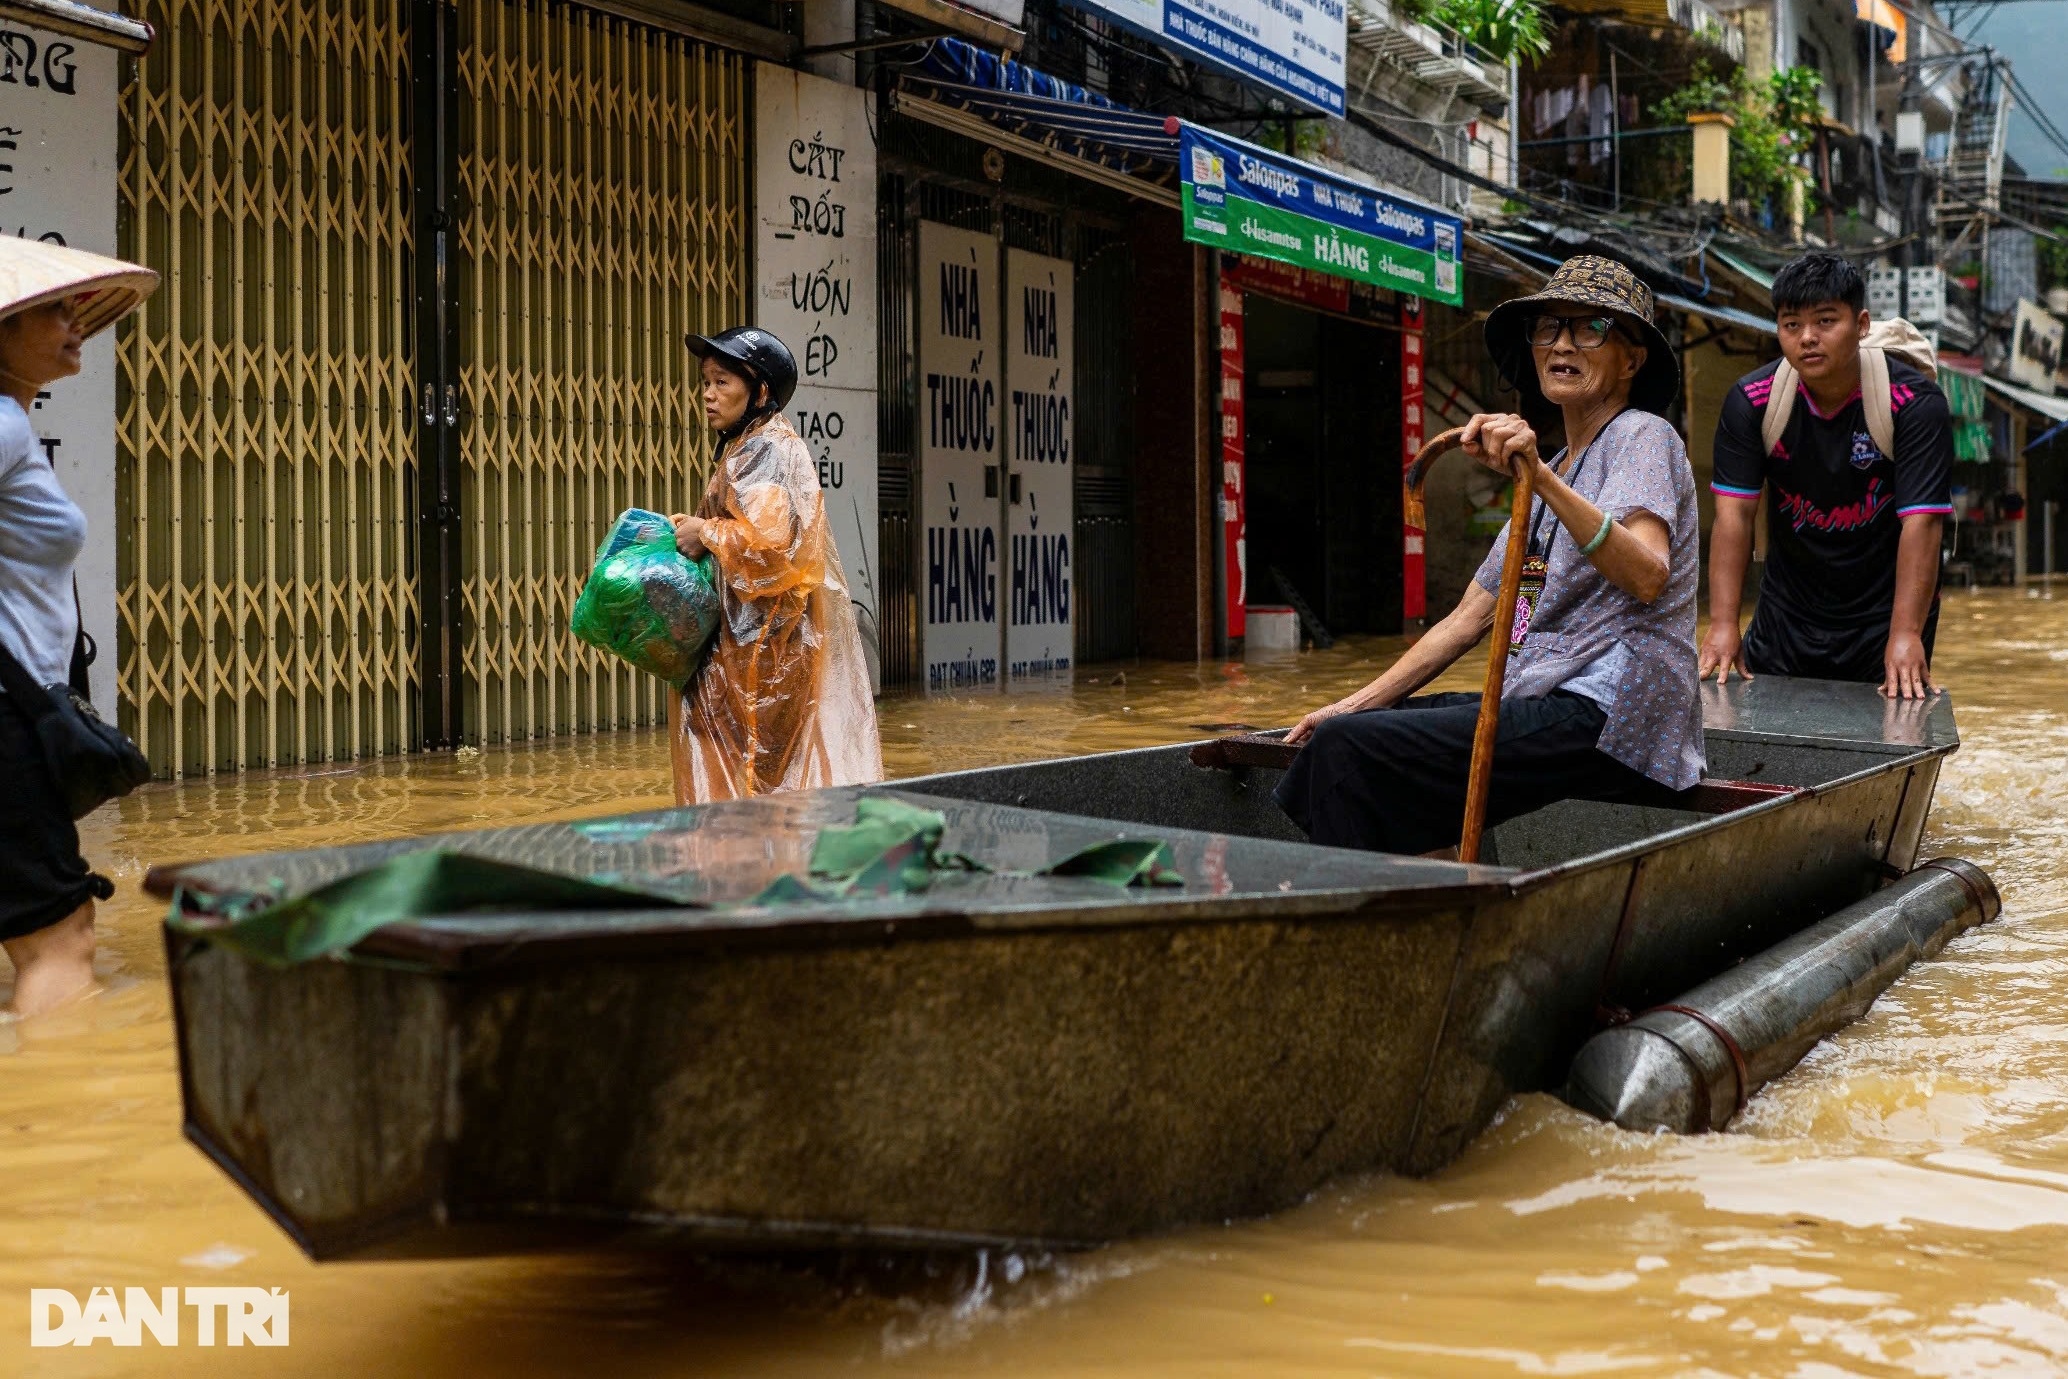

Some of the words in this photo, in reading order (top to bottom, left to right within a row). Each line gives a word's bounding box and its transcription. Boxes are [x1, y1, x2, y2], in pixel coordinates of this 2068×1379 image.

[789, 130, 845, 184] CẮT
[1195, 185, 1225, 205] Salonpas
[790, 187, 847, 240] NỐI
[1238, 154, 1301, 198] Salonpas
[1333, 190, 1365, 218] THUỐC
[1375, 199, 1426, 238] Salonpas
[791, 259, 851, 316] UỐN
[1240, 216, 1302, 252] Hisamitsu
[1314, 227, 1370, 274] HẰNG
[1378, 254, 1426, 284] Hisamitsu
[940, 246, 982, 341] NHÀ
[1024, 271, 1059, 360] NHÀ
[806, 320, 839, 377] ÉP
[797, 411, 845, 445] TẠO
[927, 349, 995, 453] THUỐC
[1012, 367, 1069, 465] THUỐC
[927, 482, 996, 625] HẰNG
[1012, 491, 1070, 627] HẰNG
